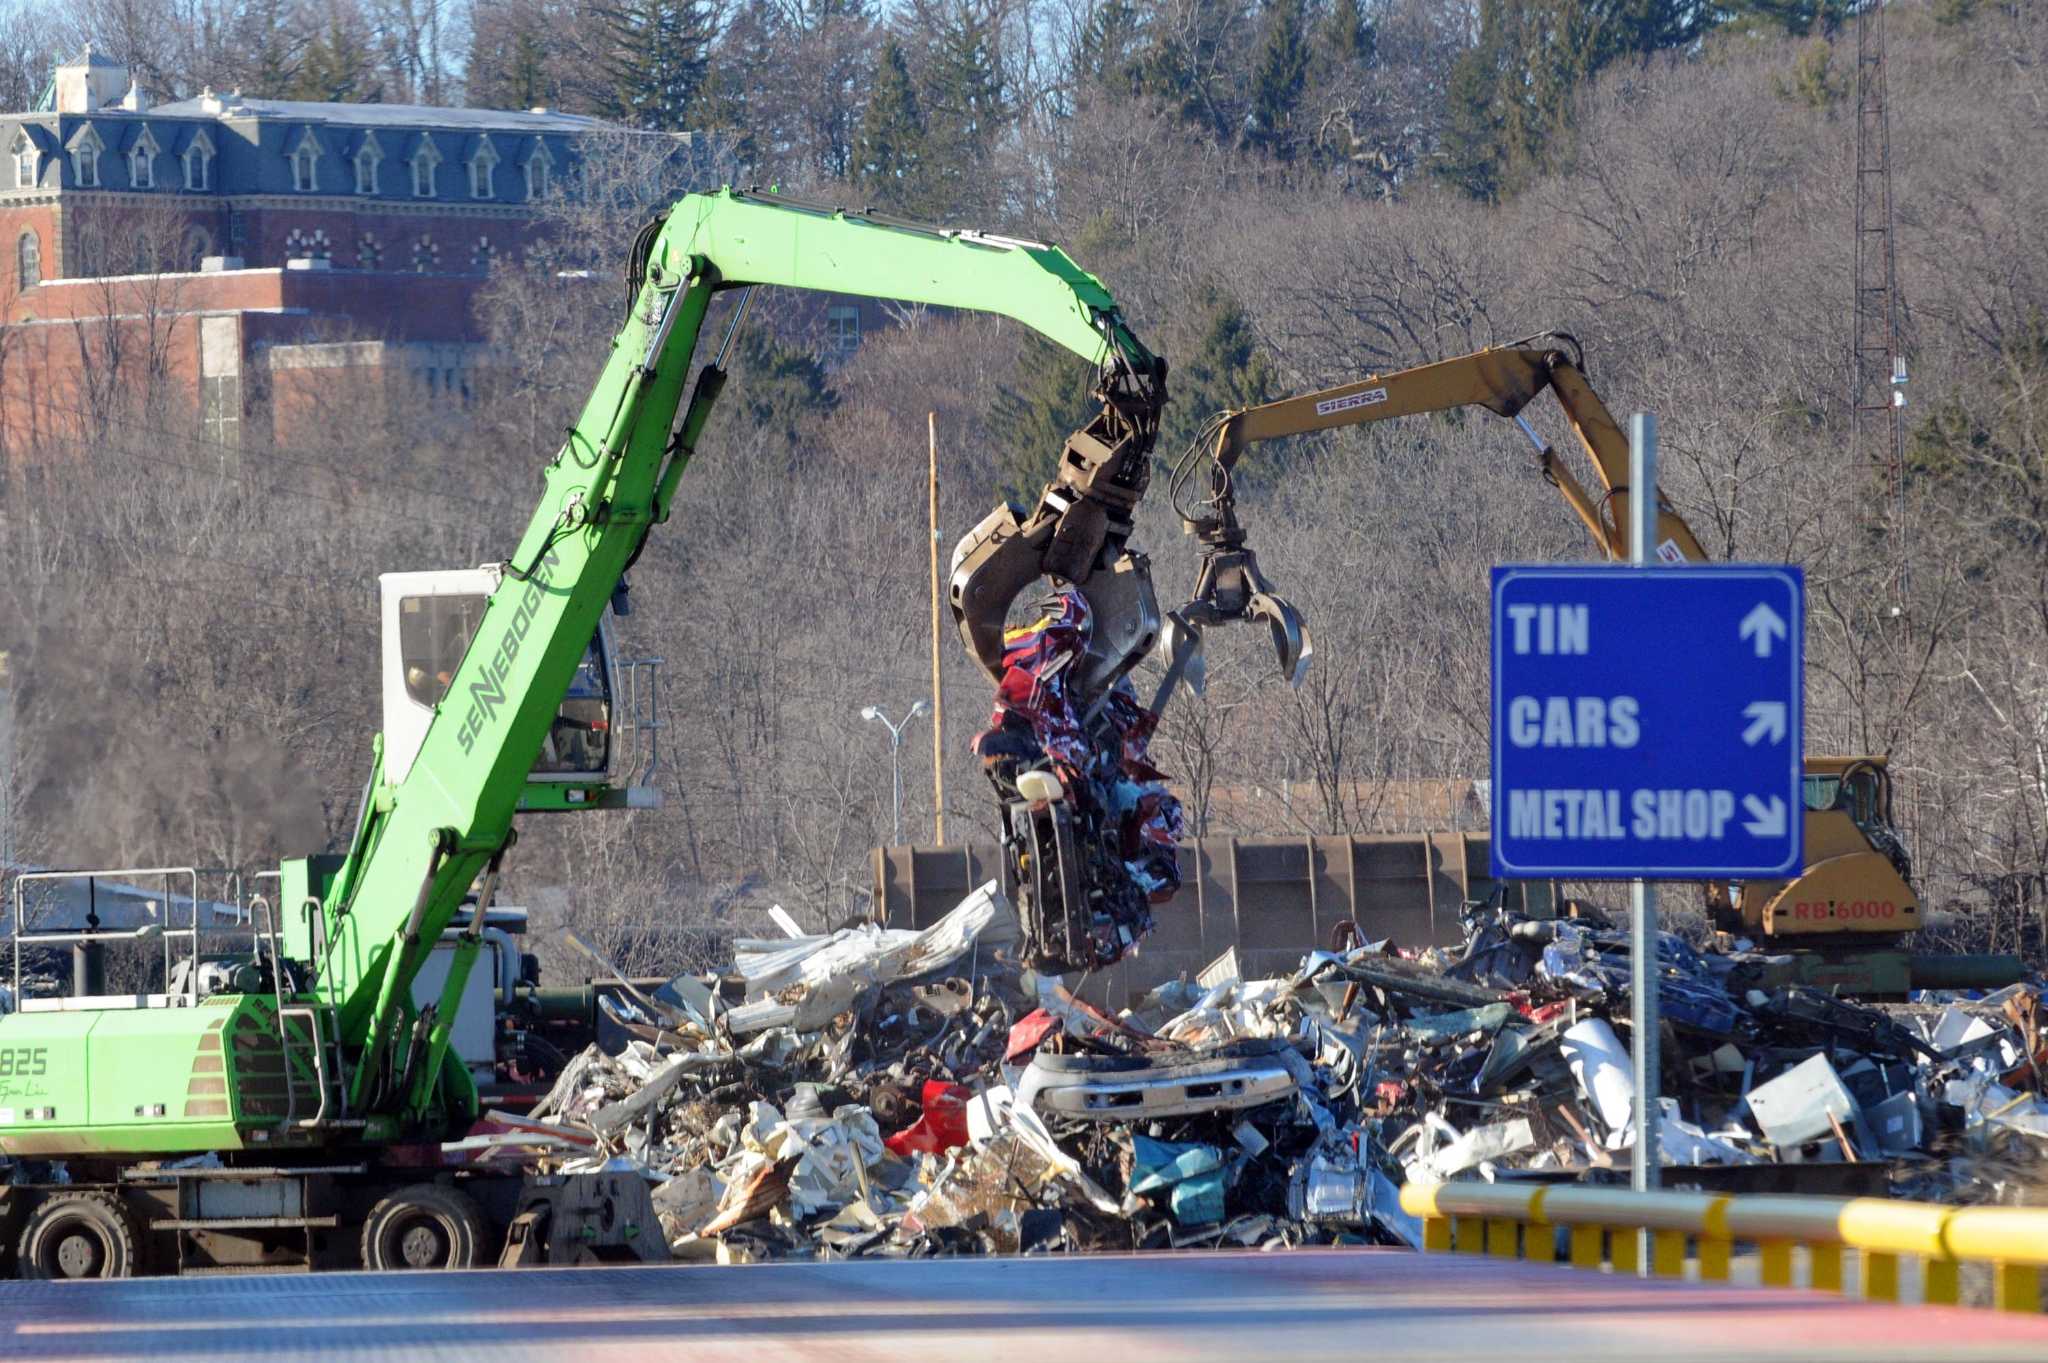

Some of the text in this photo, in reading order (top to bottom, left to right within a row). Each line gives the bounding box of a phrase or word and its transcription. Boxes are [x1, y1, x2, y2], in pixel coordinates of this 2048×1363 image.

[1318, 389, 1386, 413] SIERRA
[457, 546, 560, 757] SENNEBOGEN
[1507, 603, 1590, 655] TIN
[1509, 695, 1640, 749] CARS
[1508, 788, 1735, 840] METAL SHOP
[1836, 900, 1896, 920] 6000
[0, 1048, 48, 1076] 825
